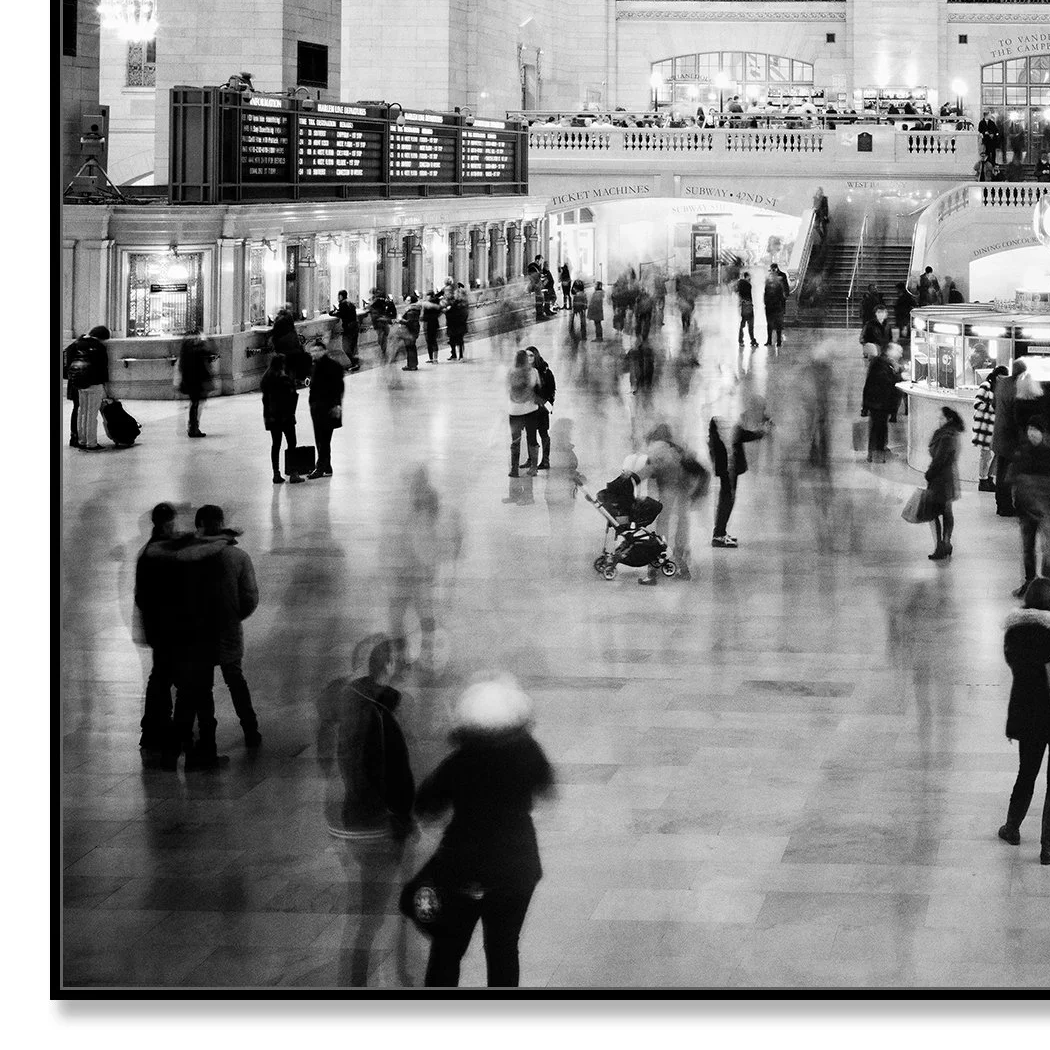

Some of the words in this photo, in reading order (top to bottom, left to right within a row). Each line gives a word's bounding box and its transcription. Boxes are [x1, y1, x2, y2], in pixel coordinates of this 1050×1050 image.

[999, 38, 1013, 47] TO
[988, 47, 1013, 58] THE
[552, 191, 590, 206] TICKET
[593, 184, 650, 198] MACHINES
[685, 187, 728, 198] SUBWAY
[735, 192, 764, 204] 42ND
[765, 197, 777, 207] ST
[973, 244, 1001, 257] DINING
